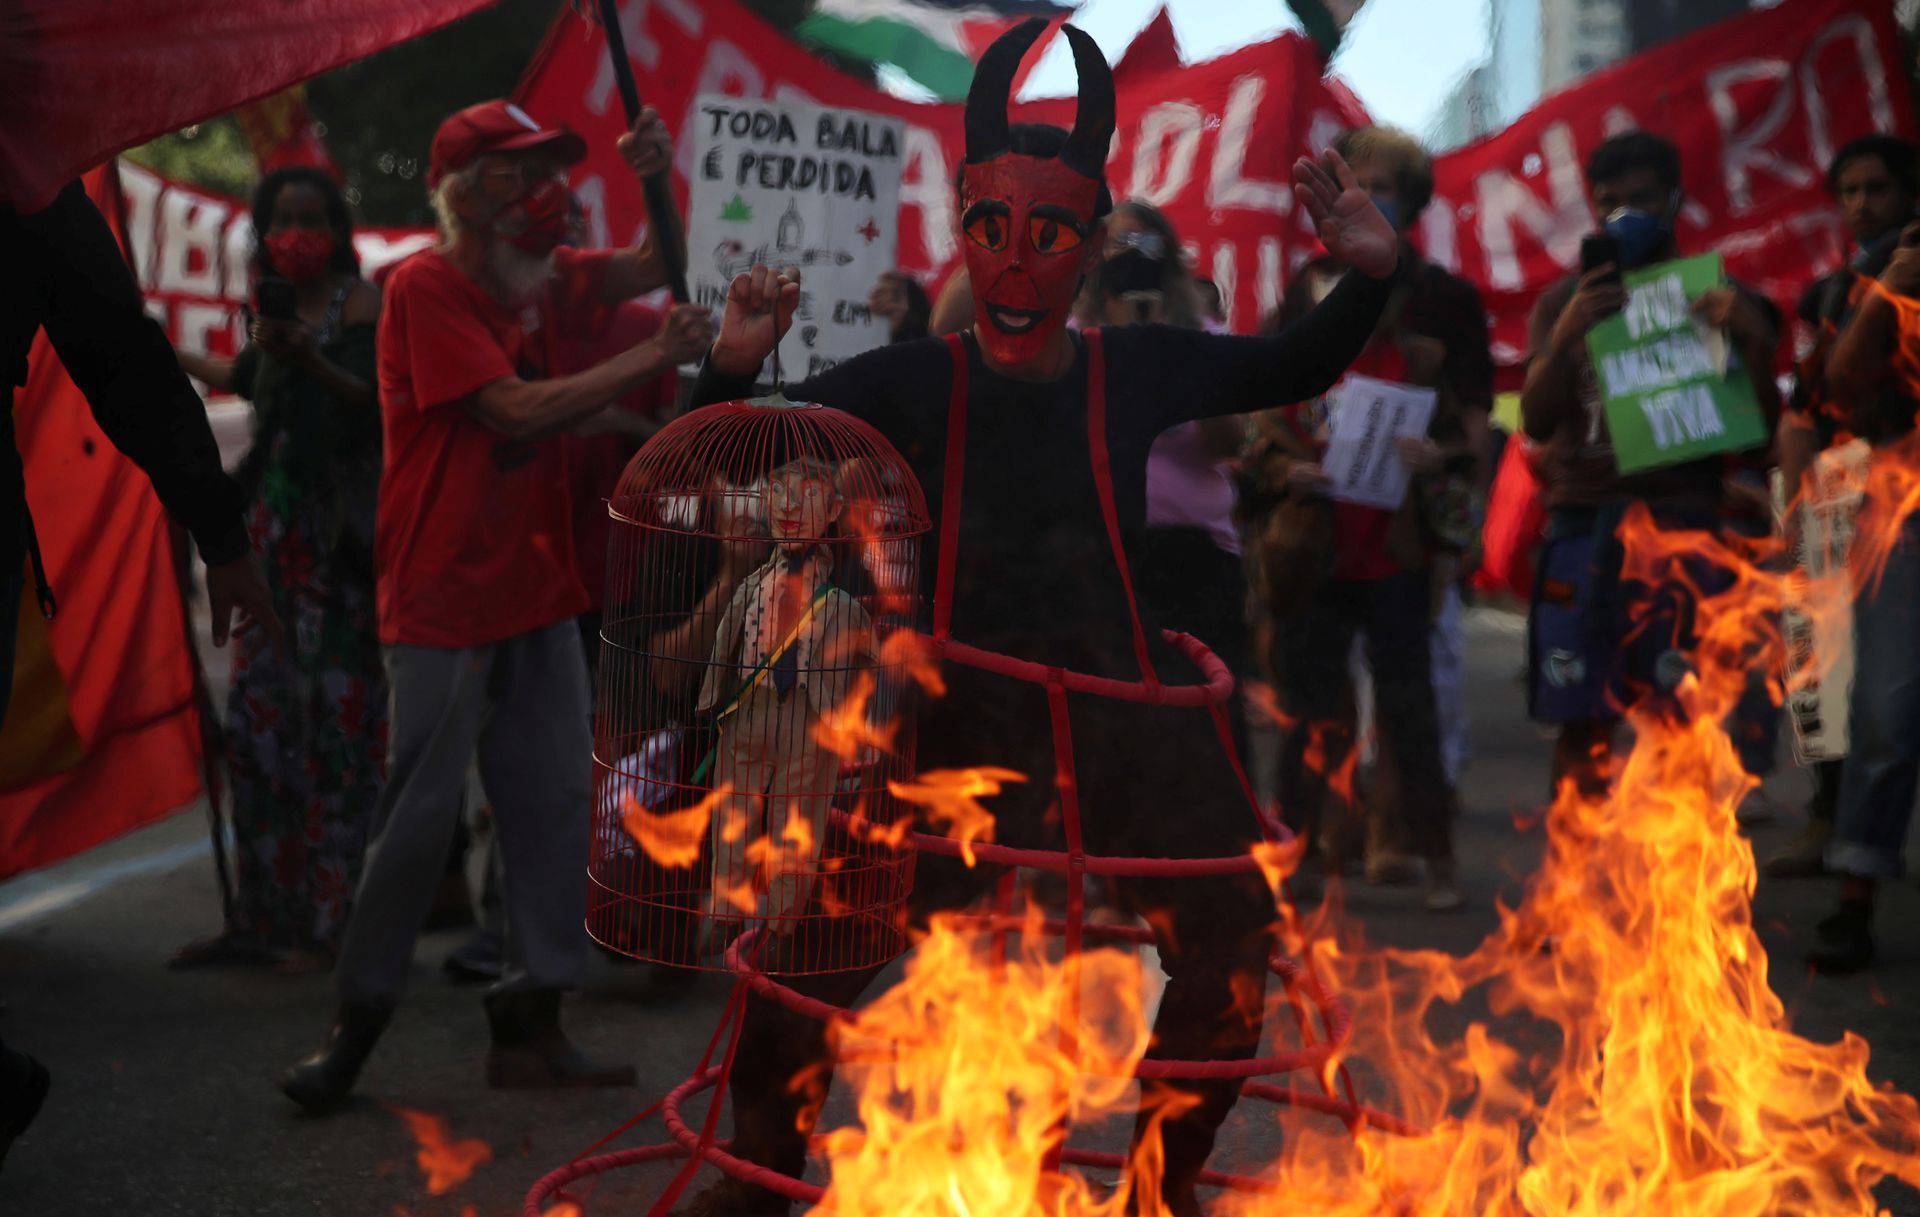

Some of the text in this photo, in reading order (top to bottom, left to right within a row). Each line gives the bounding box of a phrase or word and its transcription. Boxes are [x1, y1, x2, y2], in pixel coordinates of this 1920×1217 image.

[702, 106, 898, 157] TODA BALA
[703, 145, 877, 201] É PERDIDA
